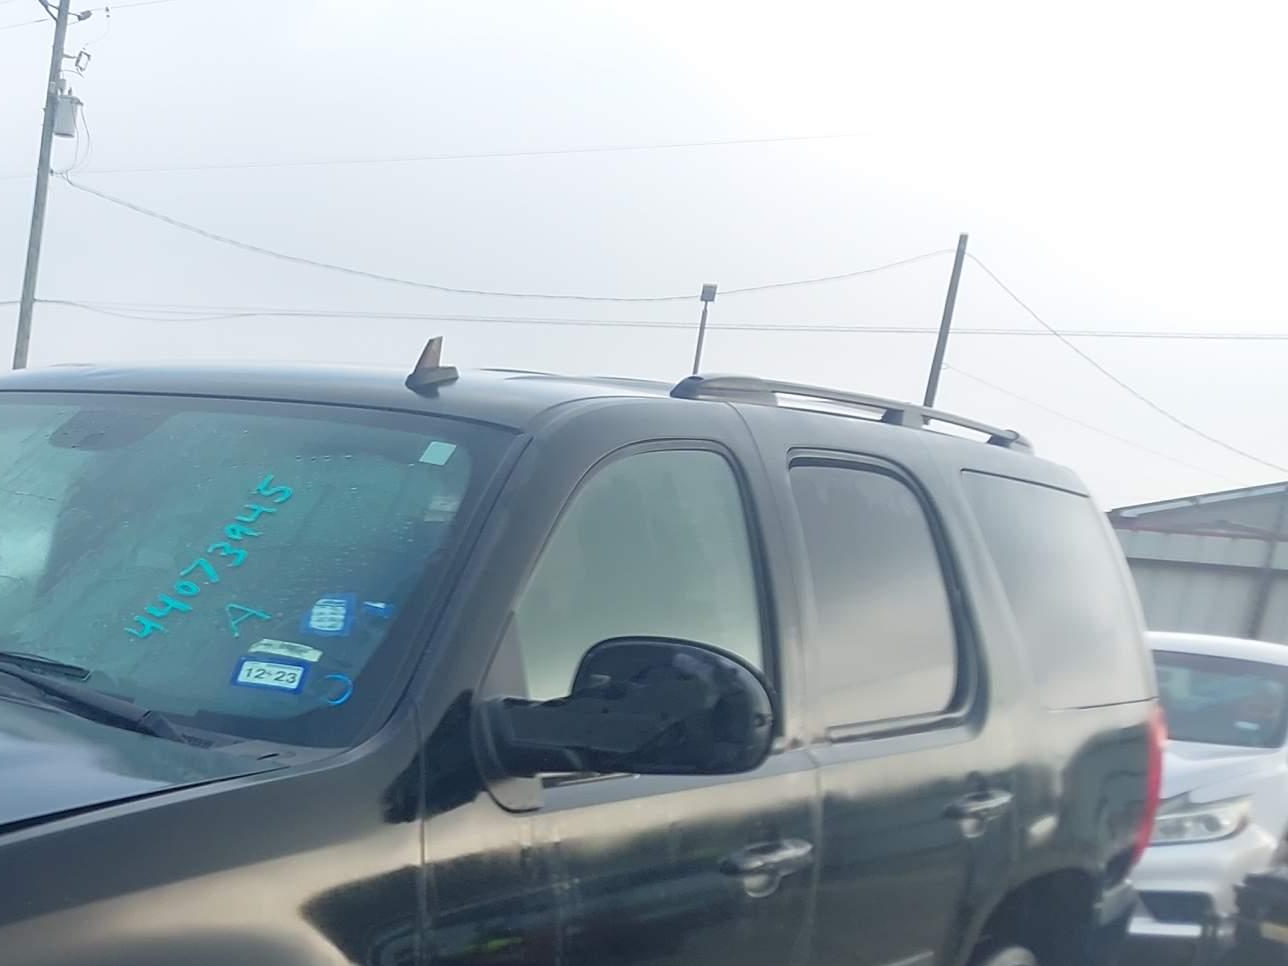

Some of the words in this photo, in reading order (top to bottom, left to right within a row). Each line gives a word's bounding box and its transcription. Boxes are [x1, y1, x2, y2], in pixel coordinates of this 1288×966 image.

[124, 474, 293, 638] 44073945
[226, 603, 272, 638] A
[245, 667, 297, 684] 12-23
